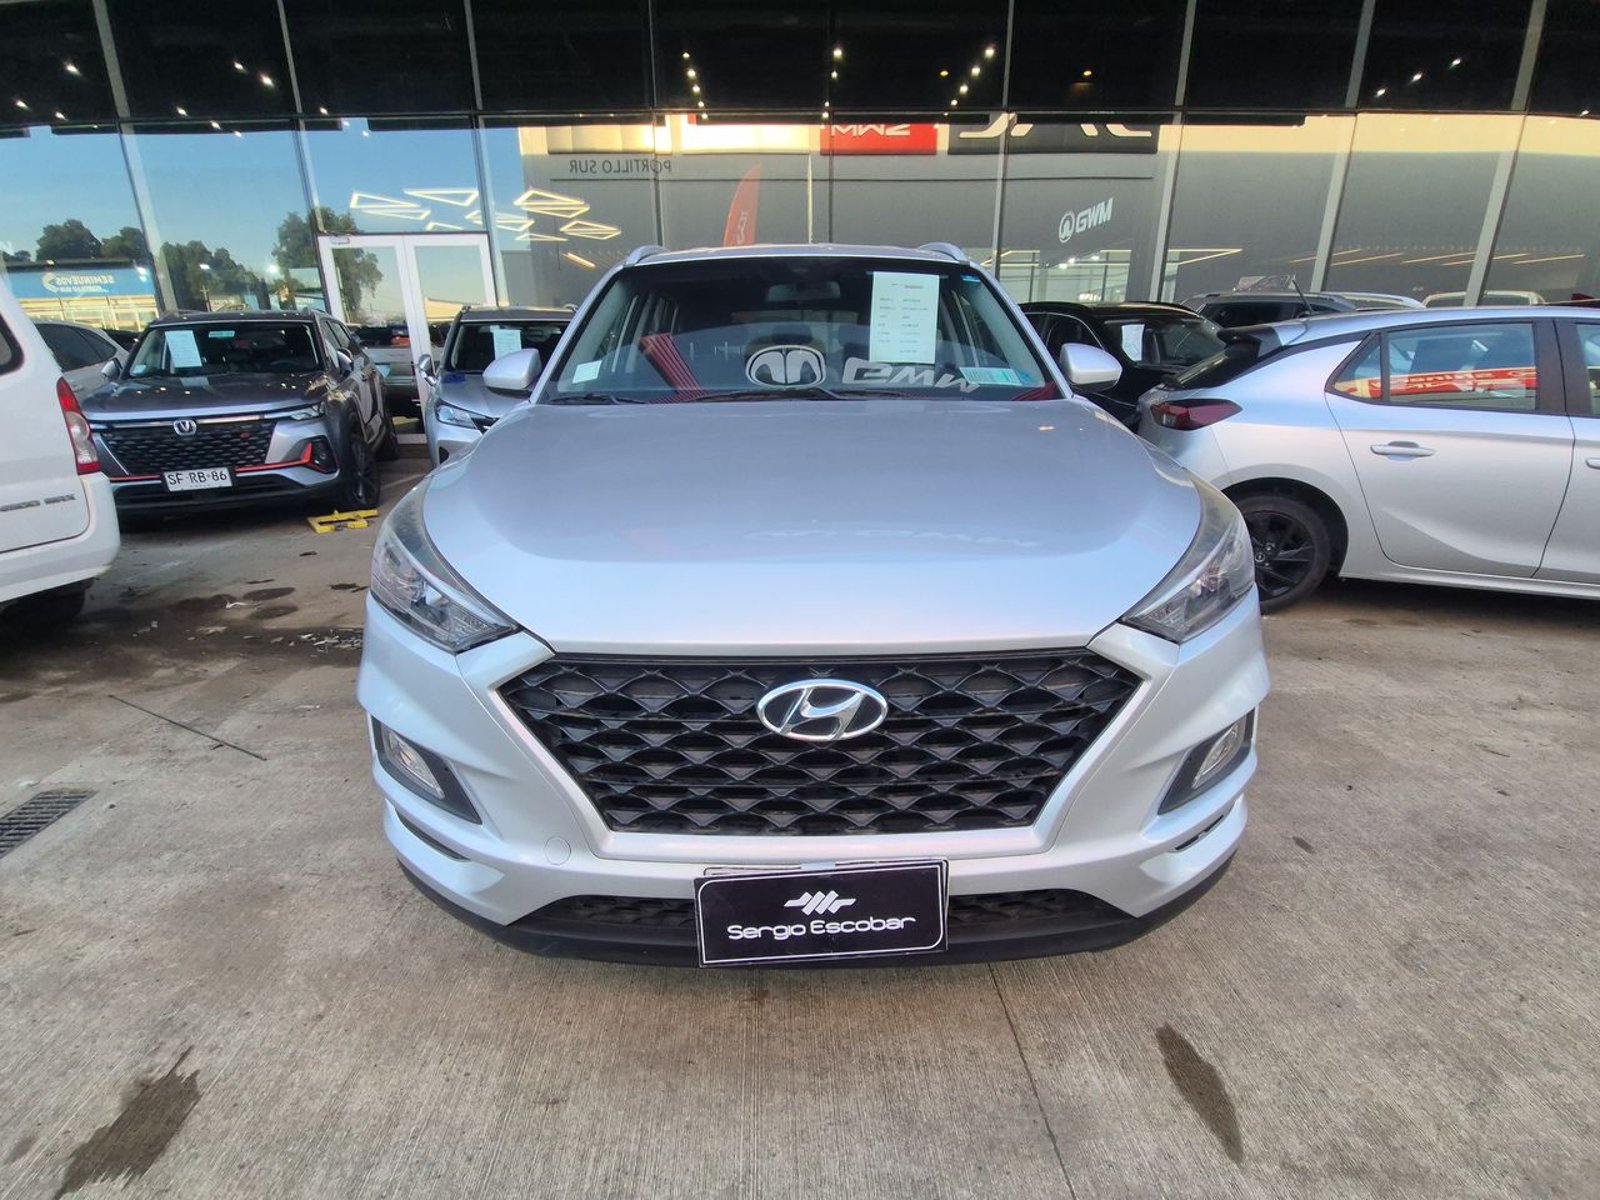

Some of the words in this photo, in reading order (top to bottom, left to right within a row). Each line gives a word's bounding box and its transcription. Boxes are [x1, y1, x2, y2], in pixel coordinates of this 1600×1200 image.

[1075, 198, 1113, 233] GWM
[727, 924, 807, 941] Sergio
[810, 916, 916, 935] Escobar
